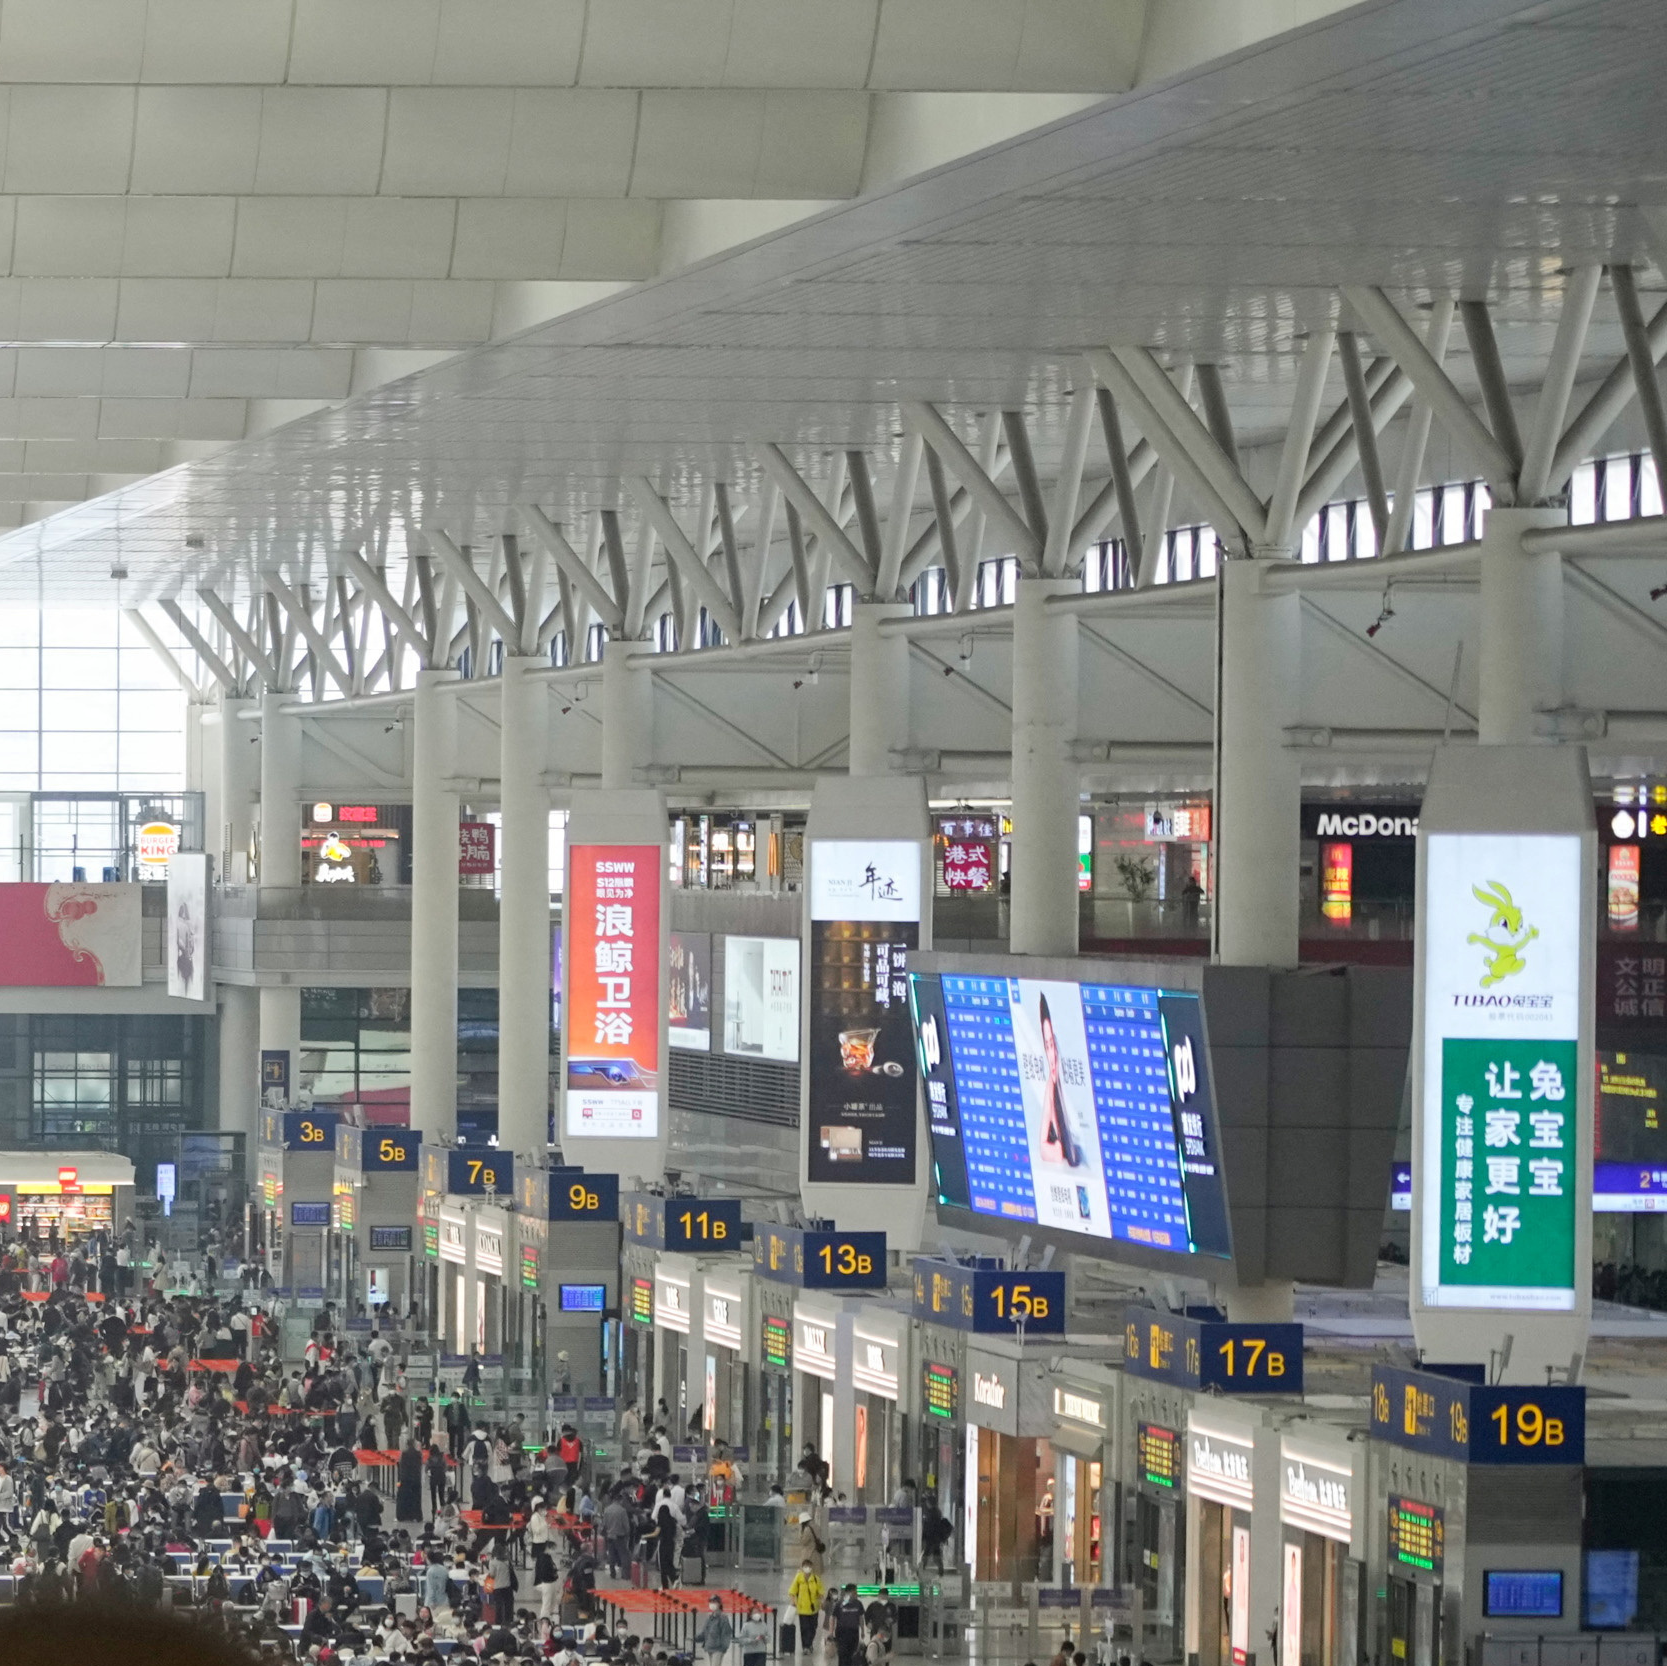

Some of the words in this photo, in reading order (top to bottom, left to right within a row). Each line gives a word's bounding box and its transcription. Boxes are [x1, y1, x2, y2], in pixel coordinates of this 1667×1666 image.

[140, 845, 177, 856] KING
[946, 846, 989, 865] 港式
[595, 861, 635, 873] SSWW
[594, 903, 634, 1045] 浪鲸卫浴
[1453, 994, 1512, 1008] TUBAO
[299, 1121, 324, 1143] 3B
[1527, 1059, 1566, 1196] 兔宝宝
[379, 1139, 406, 1162] 5B
[1482, 1060, 1523, 1244] 让家更好
[467, 1160, 496, 1185] 7B
[1453, 1093, 1475, 1265] 专注健康家居板材
[569, 1184, 600, 1210] 9B
[679, 1211, 727, 1239] 11B
[819, 1244, 872, 1275] 13B
[991, 1285, 1049, 1319] 15B
[1218, 1338, 1286, 1378] 17B
[974, 1372, 1006, 1409] Koradior
[1373, 1383, 1390, 1424] 18B
[1449, 1401, 1468, 1444] 19B
[1491, 1403, 1565, 1447] 19B
